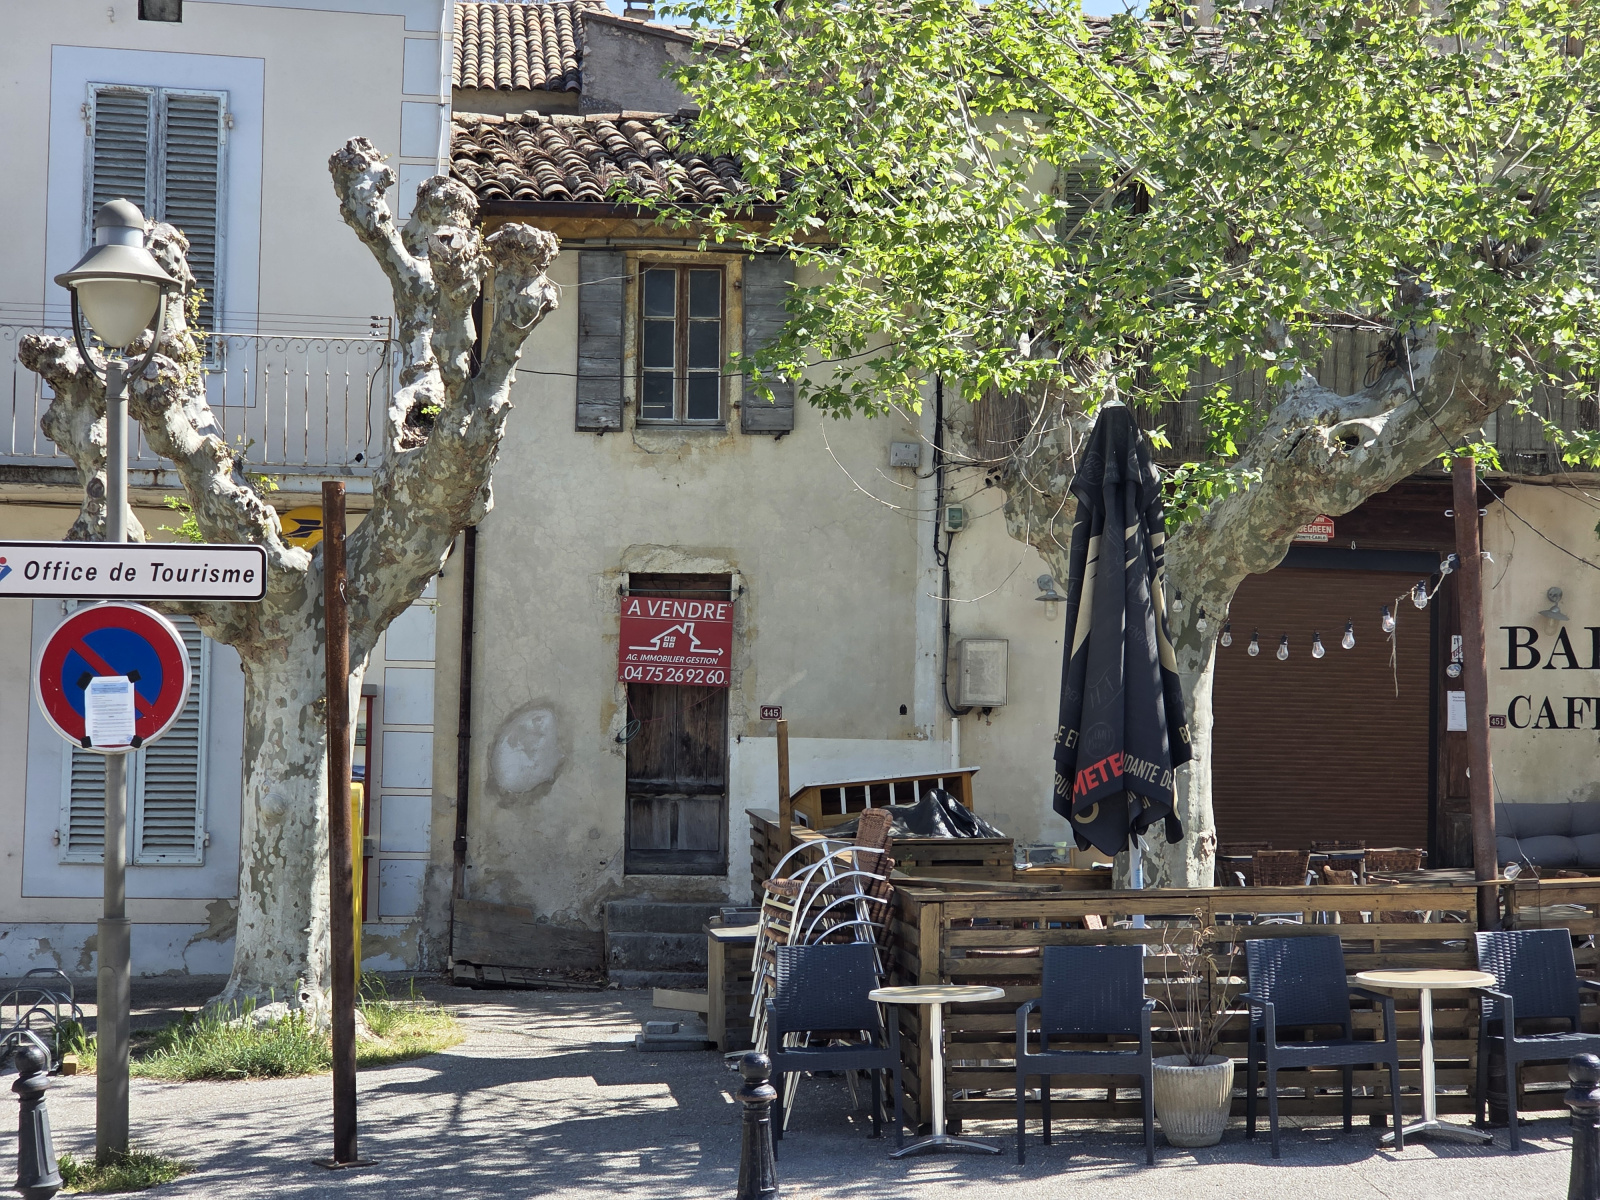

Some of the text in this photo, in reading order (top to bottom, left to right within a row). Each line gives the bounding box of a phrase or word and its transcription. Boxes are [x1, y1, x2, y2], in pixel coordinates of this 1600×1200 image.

[24, 560, 255, 583] Office de Tourisme
[628, 599, 728, 620] A VENDRE
[639, 654, 685, 664] IMMOBILIER
[686, 656, 718, 665] GESTION
[624, 666, 725, 685] 04 75 26 92 60
[763, 708, 779, 718] 445
[1490, 717, 1505, 726] 451
[1160, 769, 1174, 793] DE
